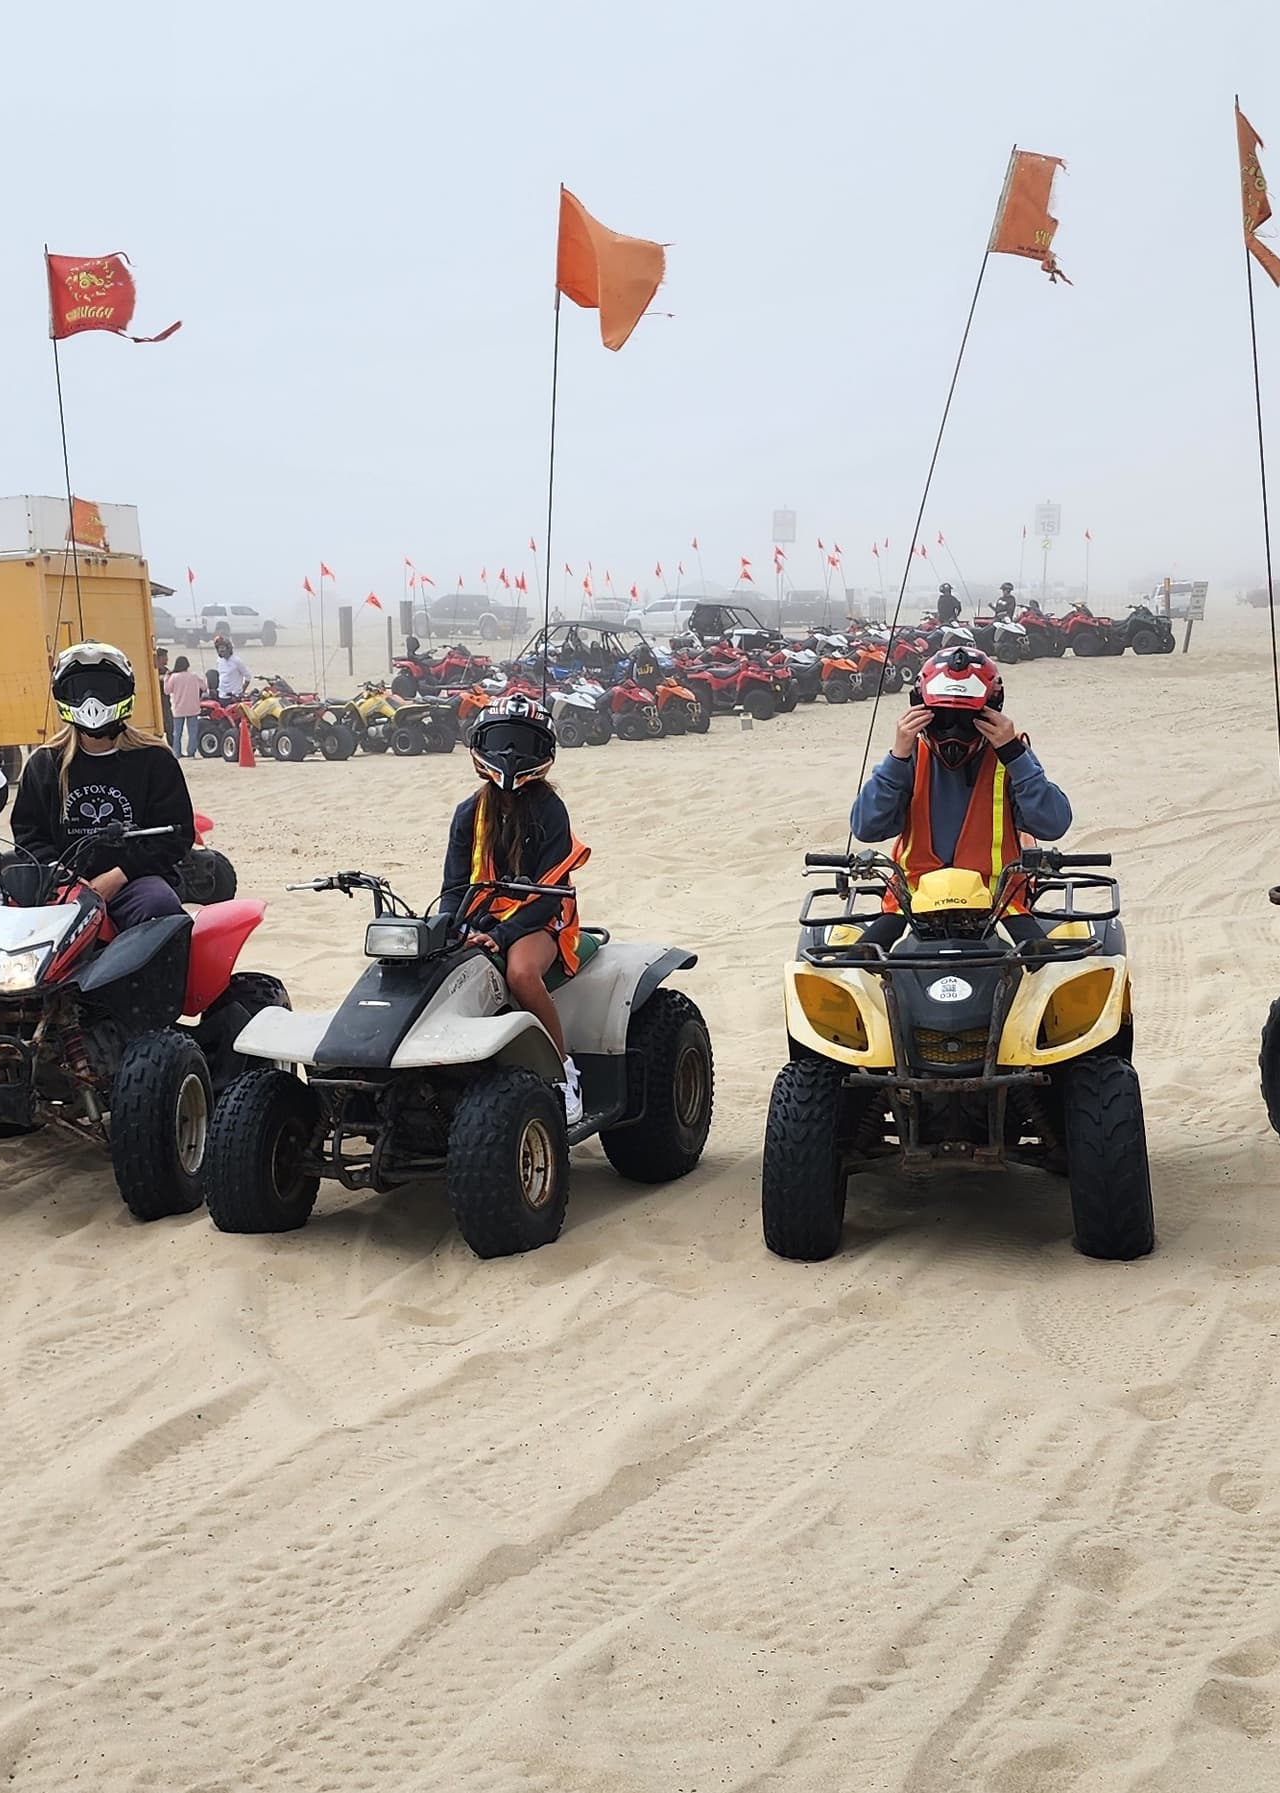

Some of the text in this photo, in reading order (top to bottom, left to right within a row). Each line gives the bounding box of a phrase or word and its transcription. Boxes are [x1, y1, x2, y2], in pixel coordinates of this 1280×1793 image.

[1040, 520, 1057, 532] 15
[83, 784, 107, 797] FOX
[934, 898, 968, 907] KYMCO
